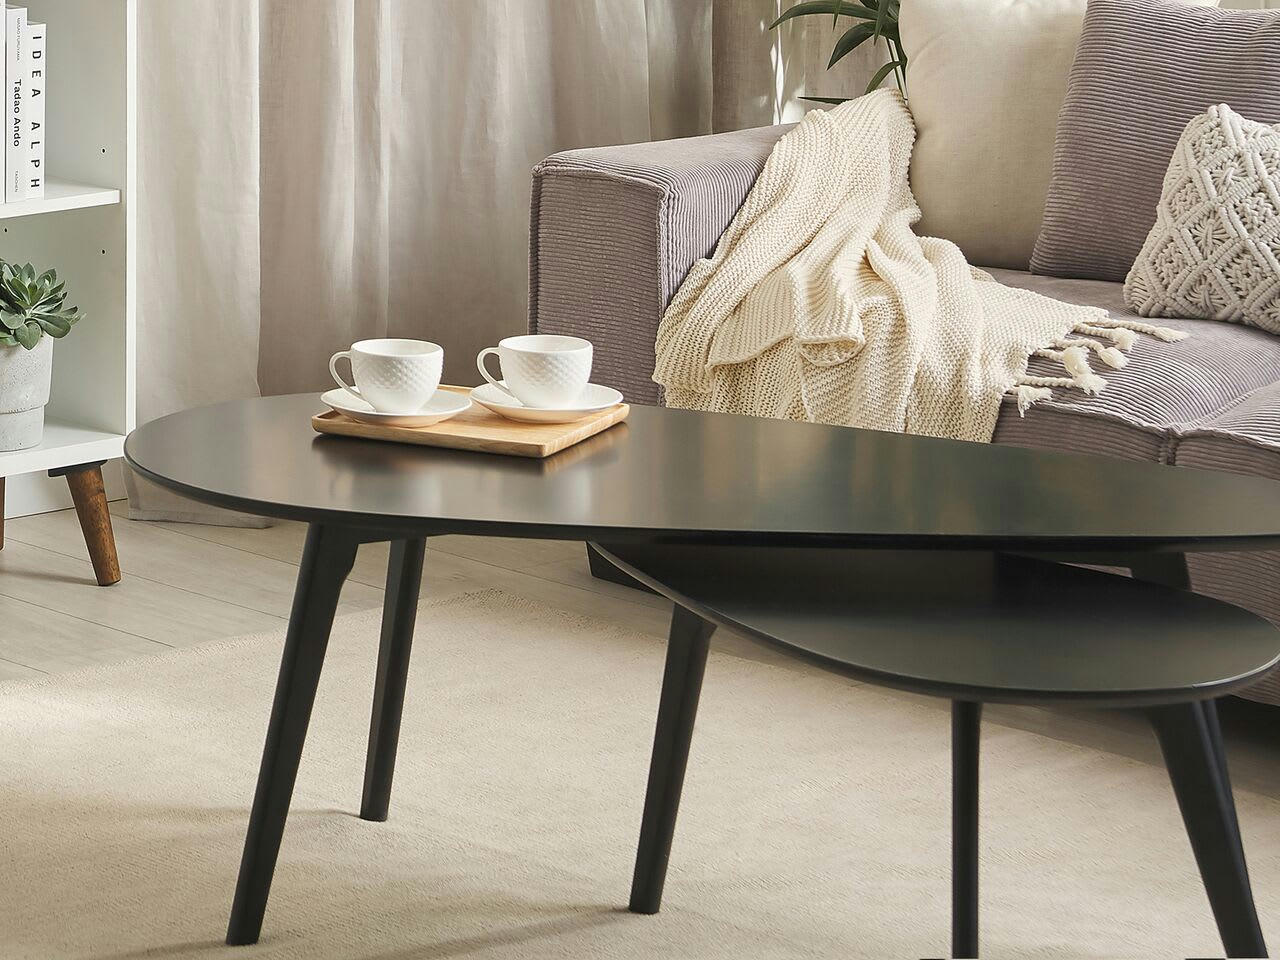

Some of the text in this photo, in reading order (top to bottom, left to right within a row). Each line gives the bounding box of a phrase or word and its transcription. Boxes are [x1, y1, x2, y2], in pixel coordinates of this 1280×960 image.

[13, 78, 22, 147] Tadao Ando
[30, 36, 42, 188] IDEA ALPH
